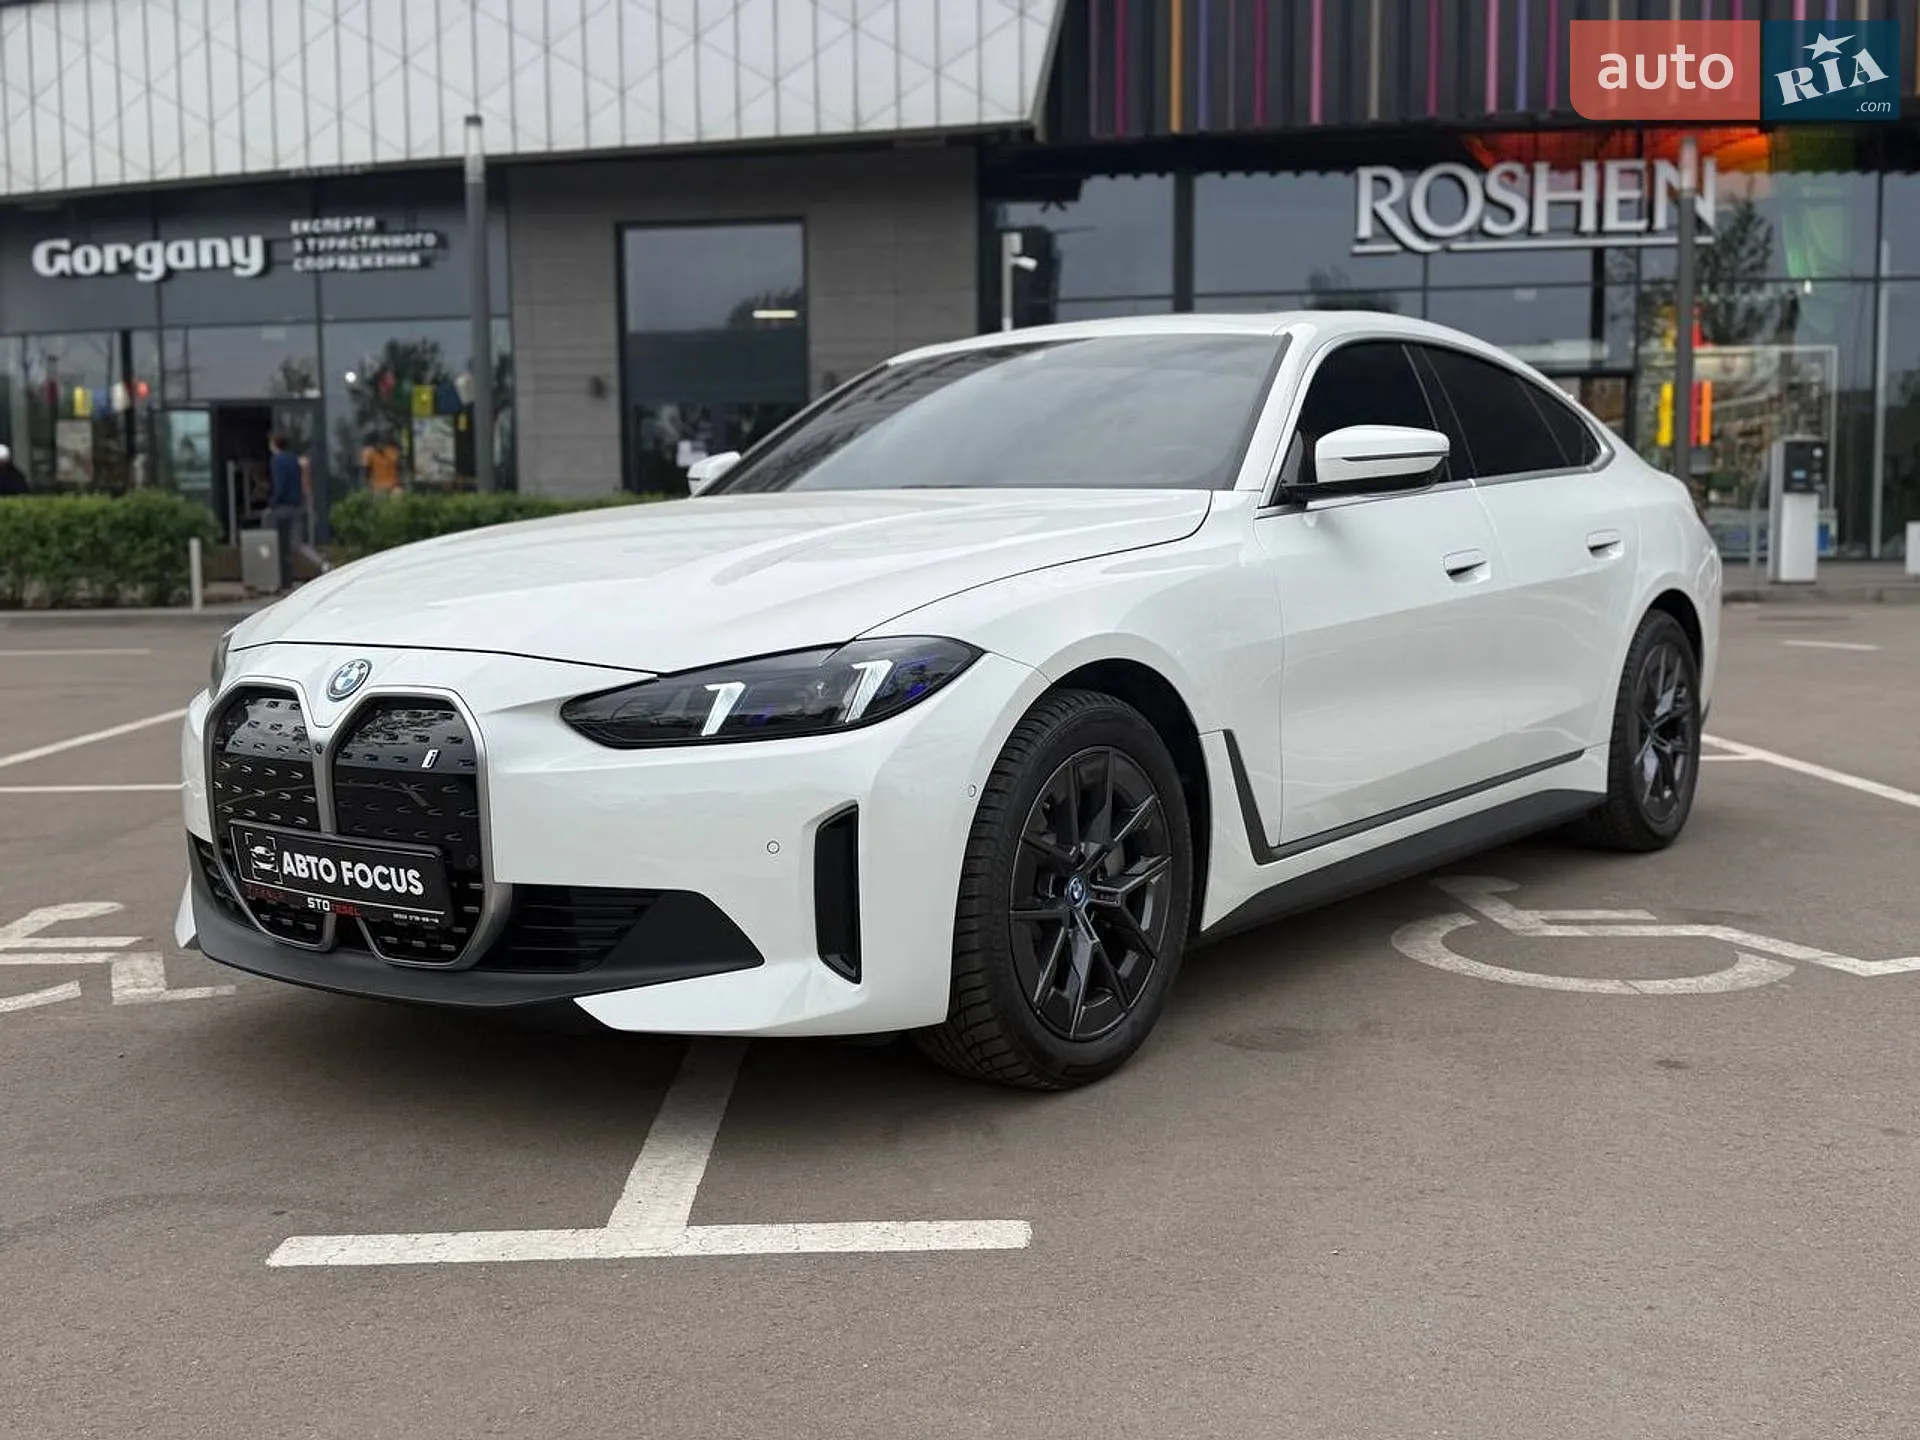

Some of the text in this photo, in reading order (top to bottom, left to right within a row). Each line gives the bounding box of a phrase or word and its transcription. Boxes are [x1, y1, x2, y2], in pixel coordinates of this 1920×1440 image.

[290, 216, 376, 235] ЕКСПЕРТИ
[1354, 158, 1718, 254] ROSHEN
[32, 235, 264, 282] Gorgany
[341, 861, 425, 896] FOCUS
